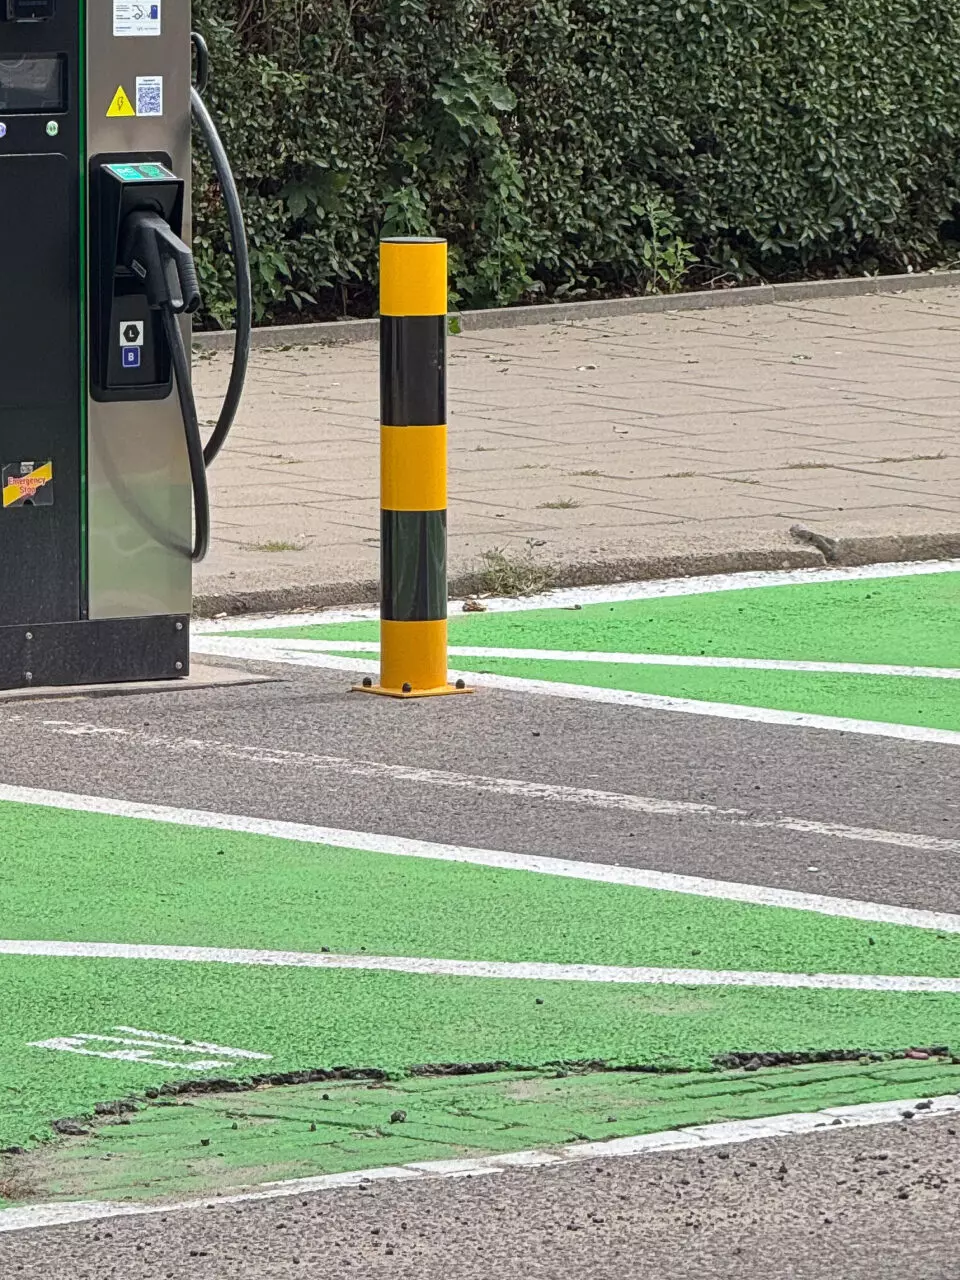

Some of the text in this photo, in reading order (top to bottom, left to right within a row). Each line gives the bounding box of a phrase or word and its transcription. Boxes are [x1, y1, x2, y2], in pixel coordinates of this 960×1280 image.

[128, 329, 135, 337] L
[127, 352, 135, 362] B
[8, 477, 46, 486] Emergency
[19, 486, 36, 496] Stop
